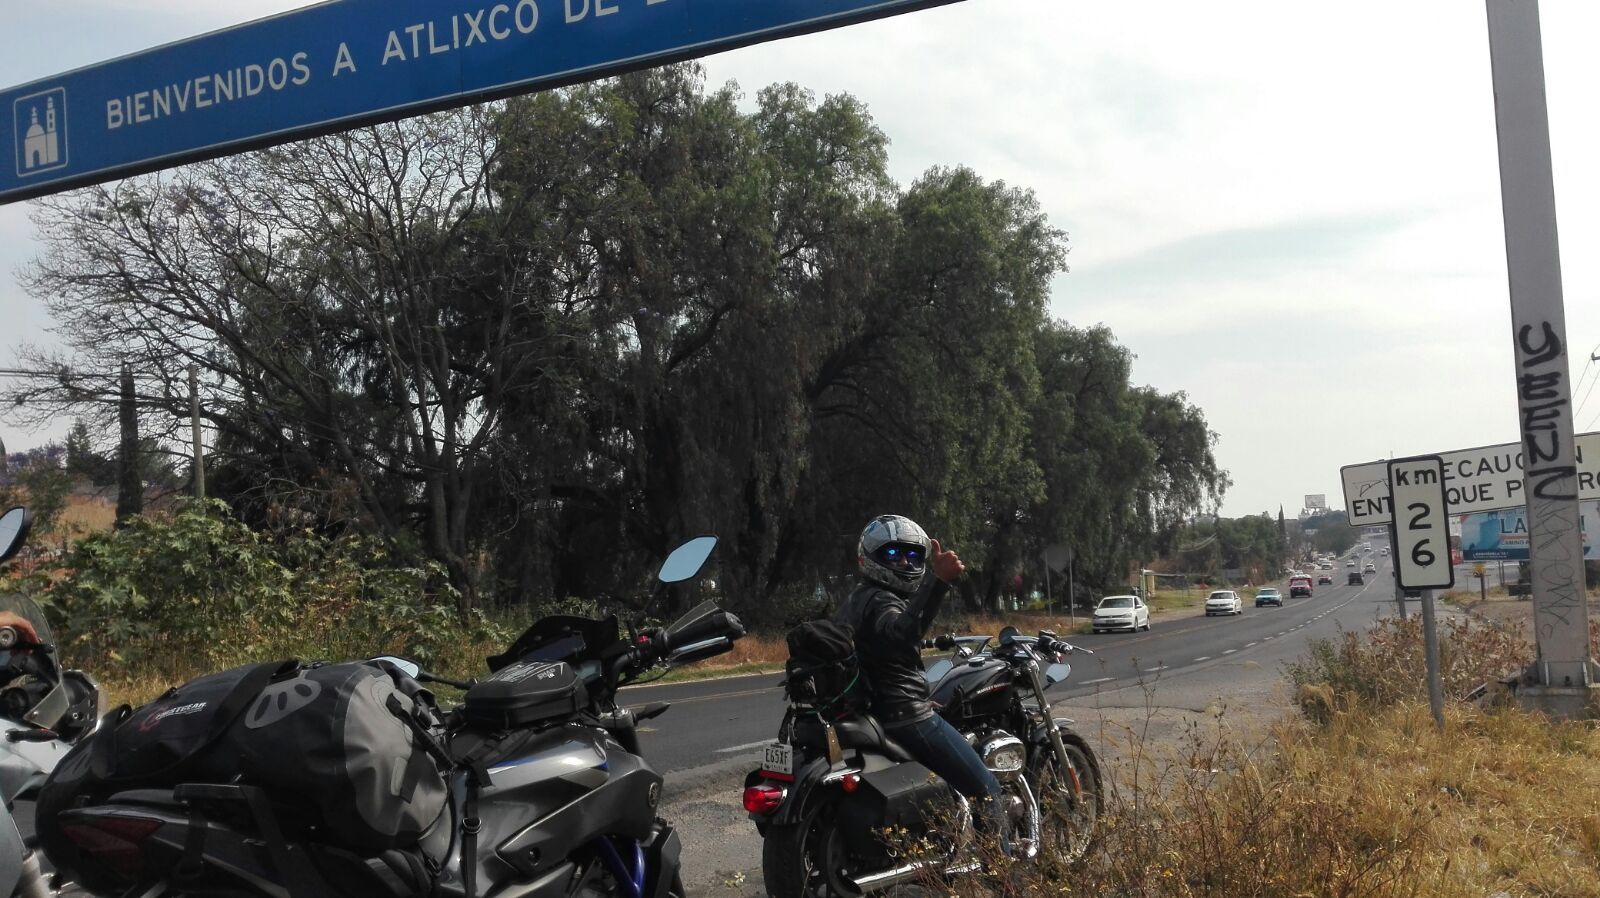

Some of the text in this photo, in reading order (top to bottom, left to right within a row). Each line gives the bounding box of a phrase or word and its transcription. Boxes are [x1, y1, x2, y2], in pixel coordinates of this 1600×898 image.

[106, 51, 310, 130] BIENVENIDOS
[332, 42, 357, 77] A
[382, 0, 539, 65] ATLIXCO
[1395, 467, 1438, 486] km
[1407, 502, 1432, 530] 2
[1411, 538, 1436, 567] 6
